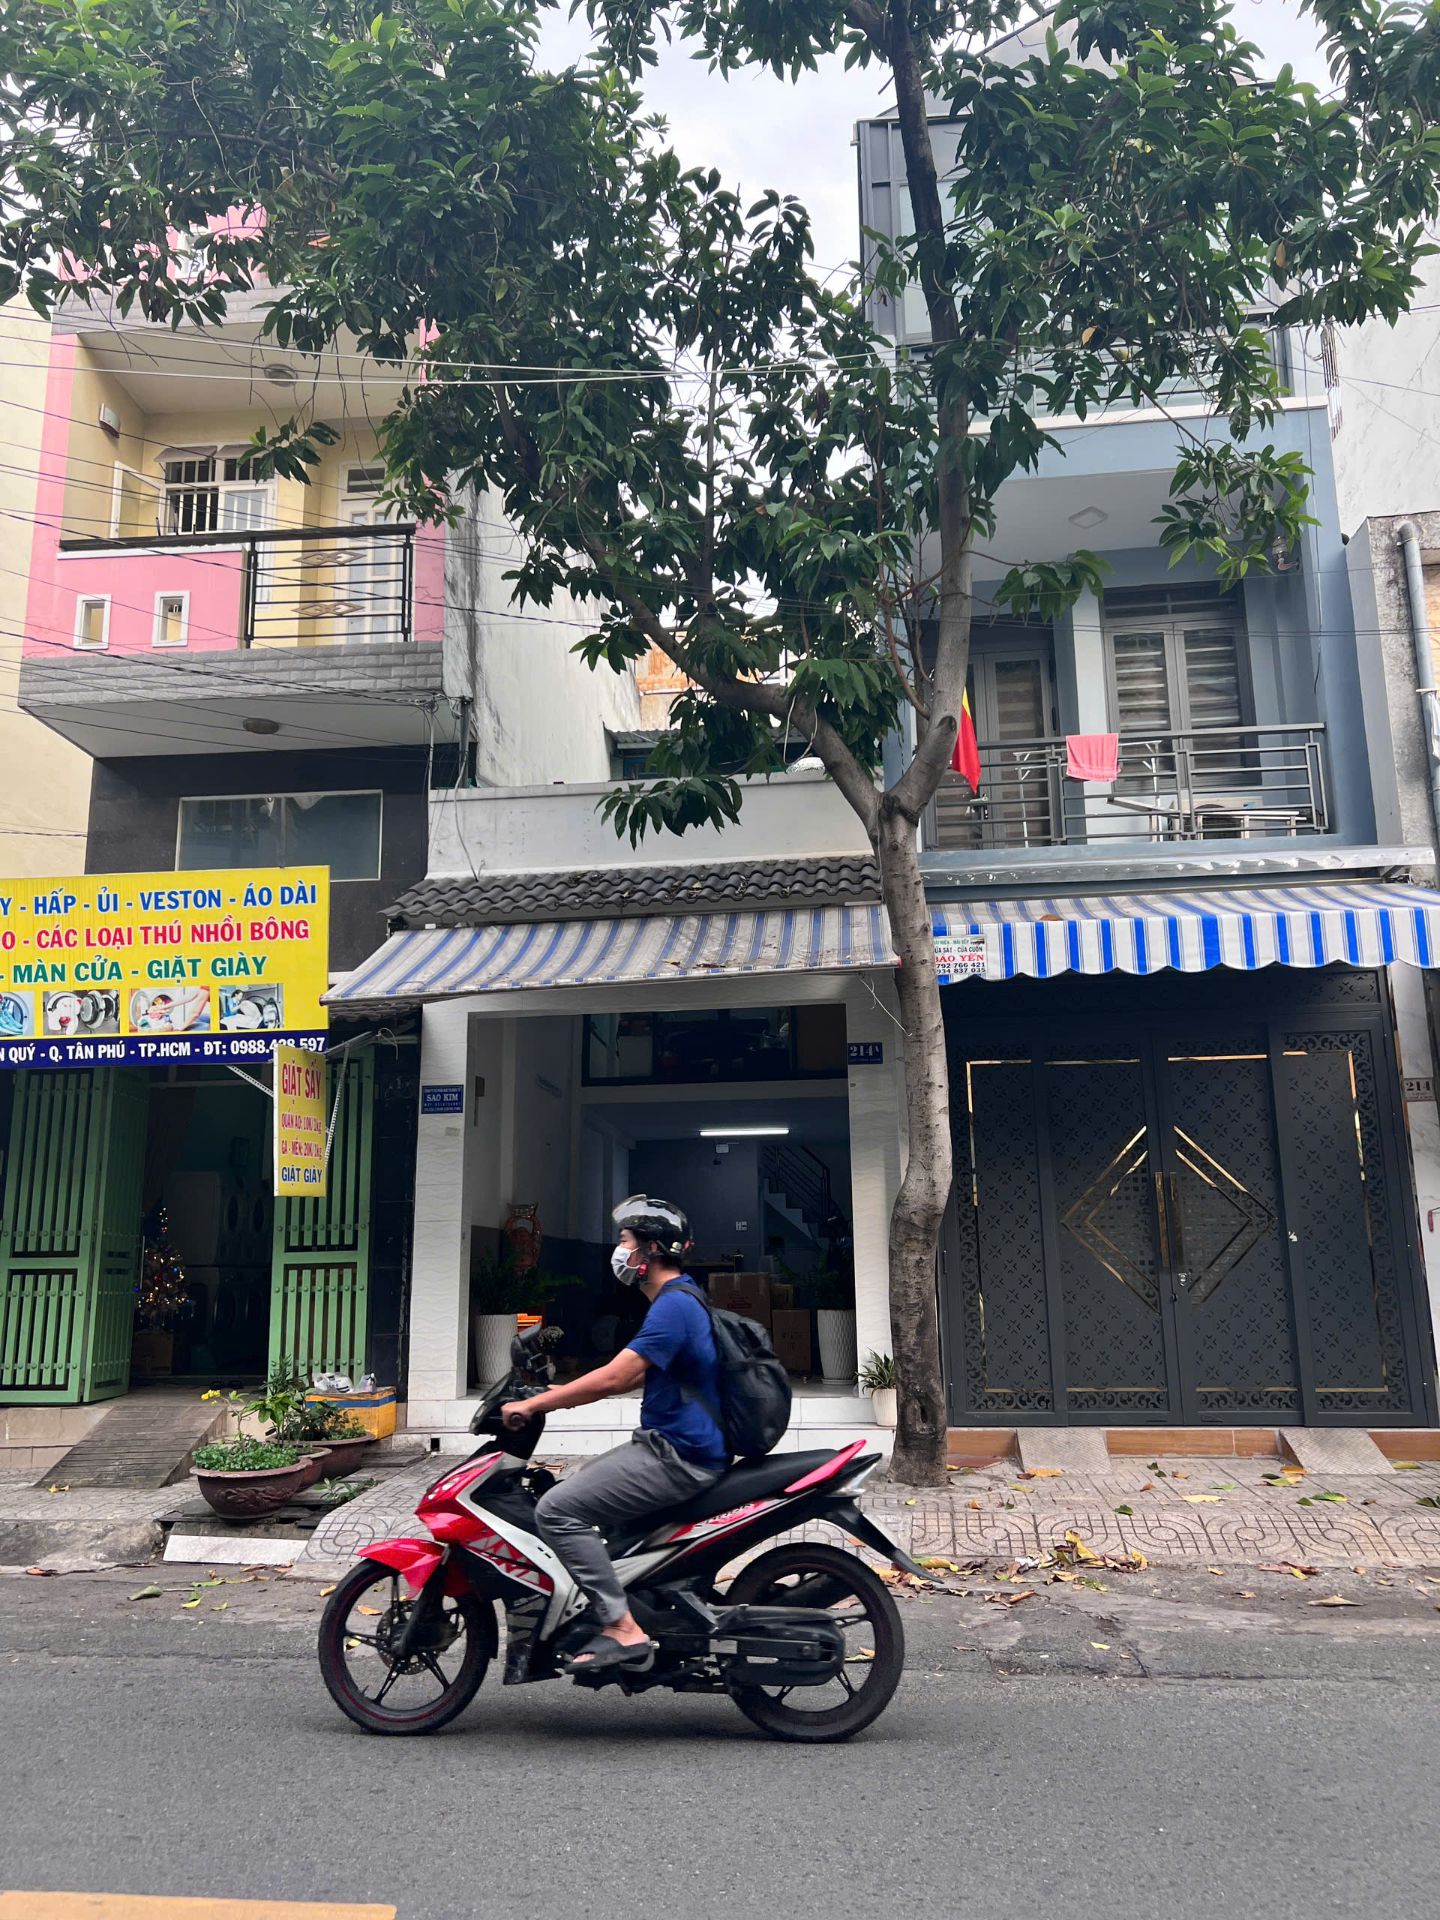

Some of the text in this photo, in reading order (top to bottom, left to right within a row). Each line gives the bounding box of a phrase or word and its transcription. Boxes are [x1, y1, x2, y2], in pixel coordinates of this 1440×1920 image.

[34, 888, 77, 915] HẤP
[98, 886, 118, 912] ỦI
[140, 889, 222, 911] VESTON
[243, 882, 272, 906] ÁO
[280, 880, 316, 905] DÀI
[36, 924, 78, 949] CÁC
[86, 927, 132, 950] LOẠI
[140, 920, 182, 945] THÚ
[192, 914, 242, 943] NHỒI
[250, 916, 309, 940] BÔNG
[14, 958, 66, 983] MÀN
[74, 954, 122, 982] CỬA
[147, 955, 202, 984] GIẶT
[210, 952, 267, 977] GIÀY
[8, 1042, 36, 1064] QUÝ
[49, 1046, 62, 1063] Q.
[66, 1042, 94, 1060] TÂN
[98, 1040, 126, 1059] PHÚ
[138, 1042, 190, 1058] TP.HCM
[204, 1041, 226, 1056] ĐT:
[282, 1059, 302, 1104] GIẶT
